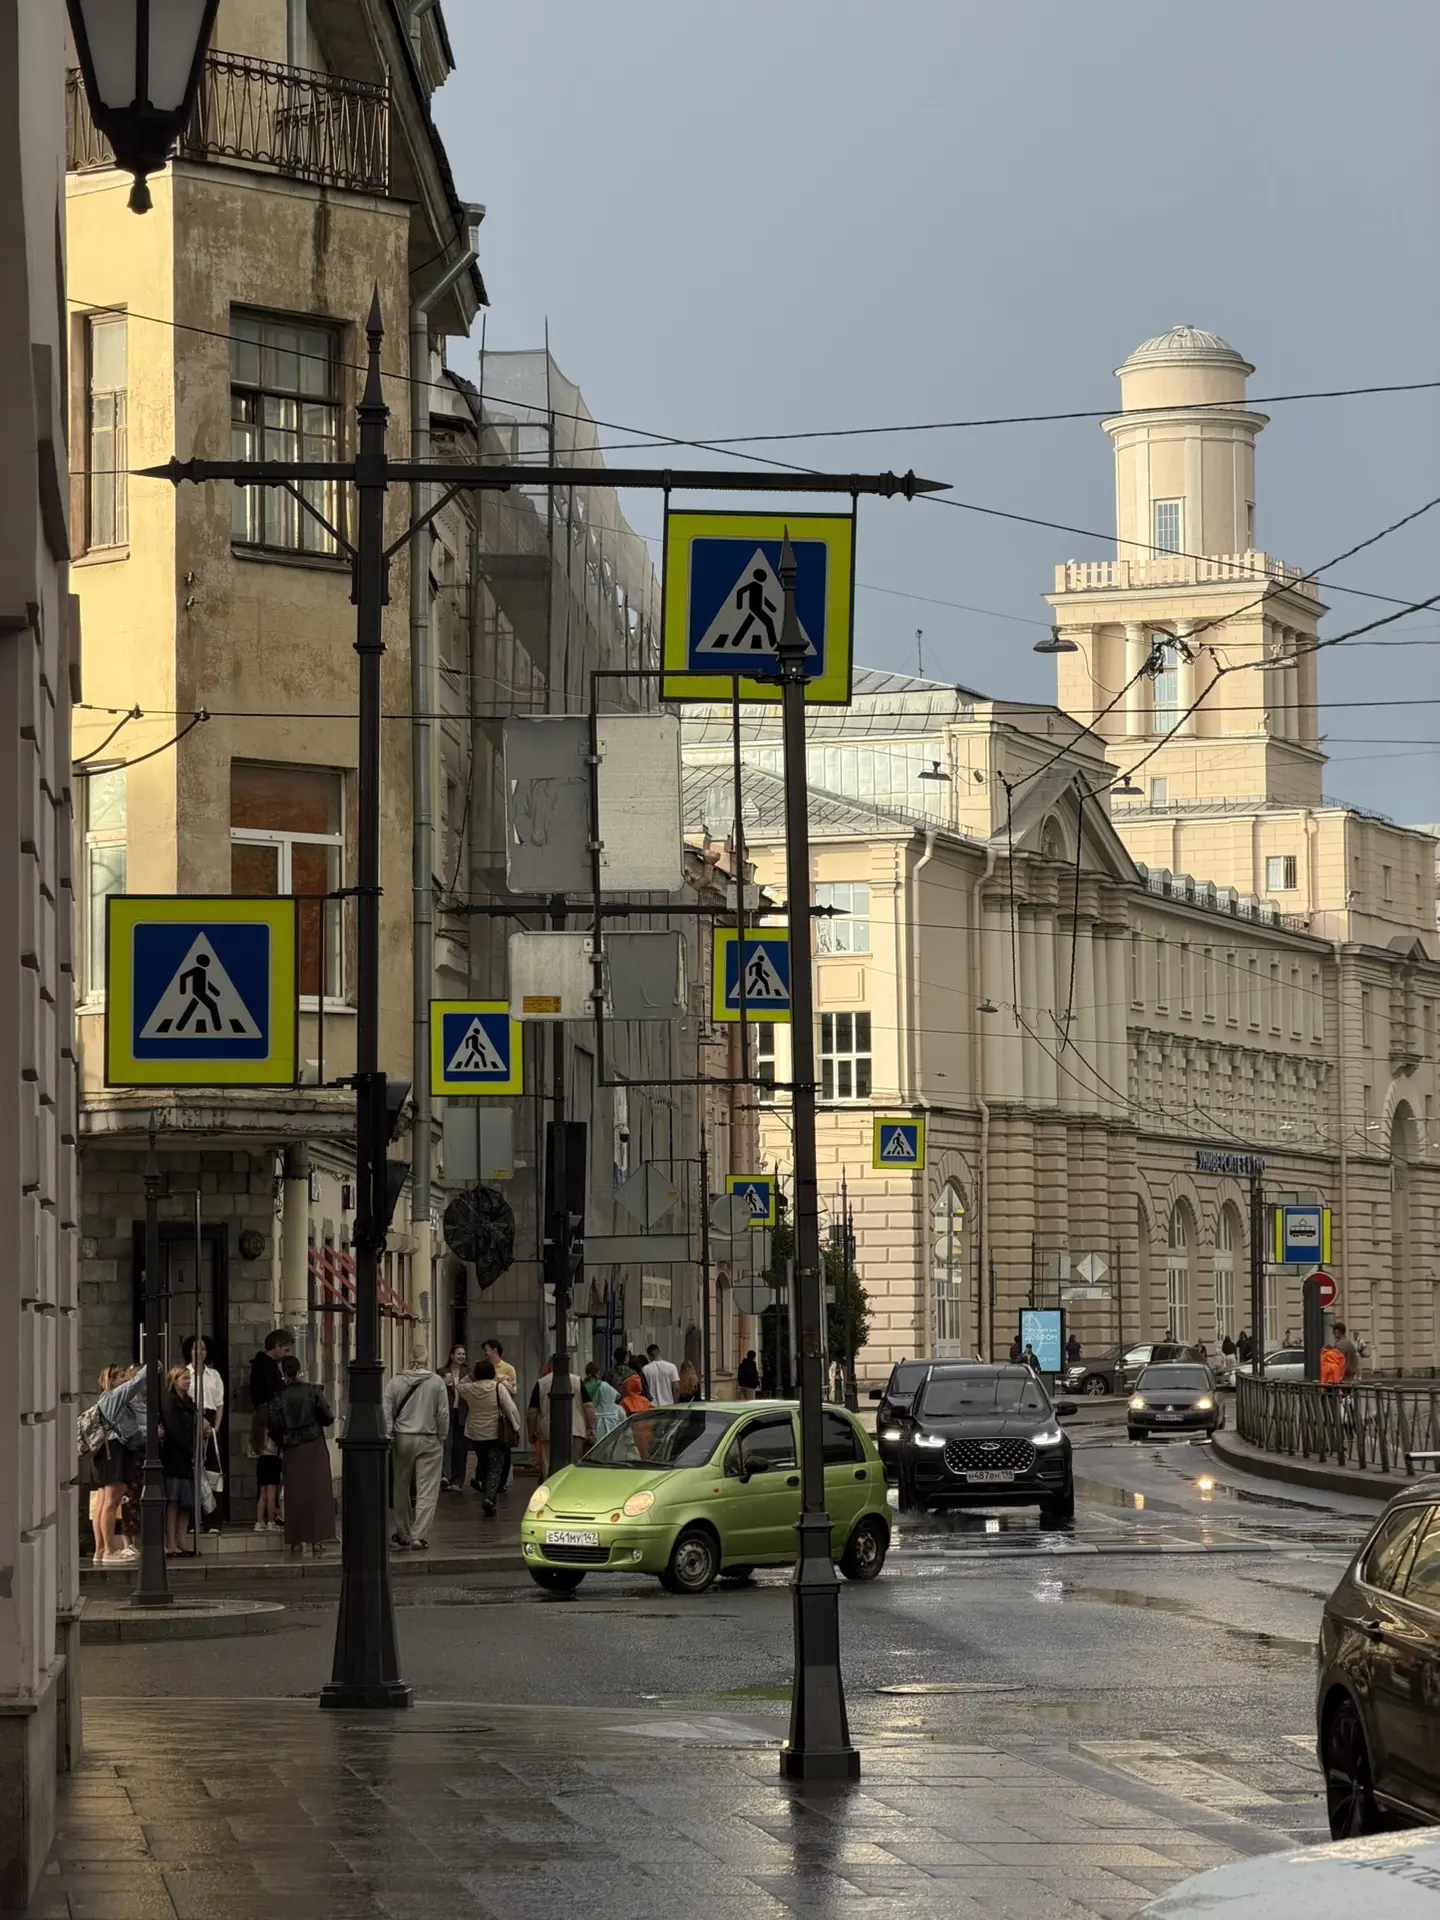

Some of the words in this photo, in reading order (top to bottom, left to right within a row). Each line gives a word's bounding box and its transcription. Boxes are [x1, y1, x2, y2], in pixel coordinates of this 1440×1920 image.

[968, 1471, 1000, 1480] Н487ВН
[548, 1531, 581, 1543] Е541МУ
[583, 1532, 597, 1542] 147
[1339, 1853, 1440, 1892] Доста
